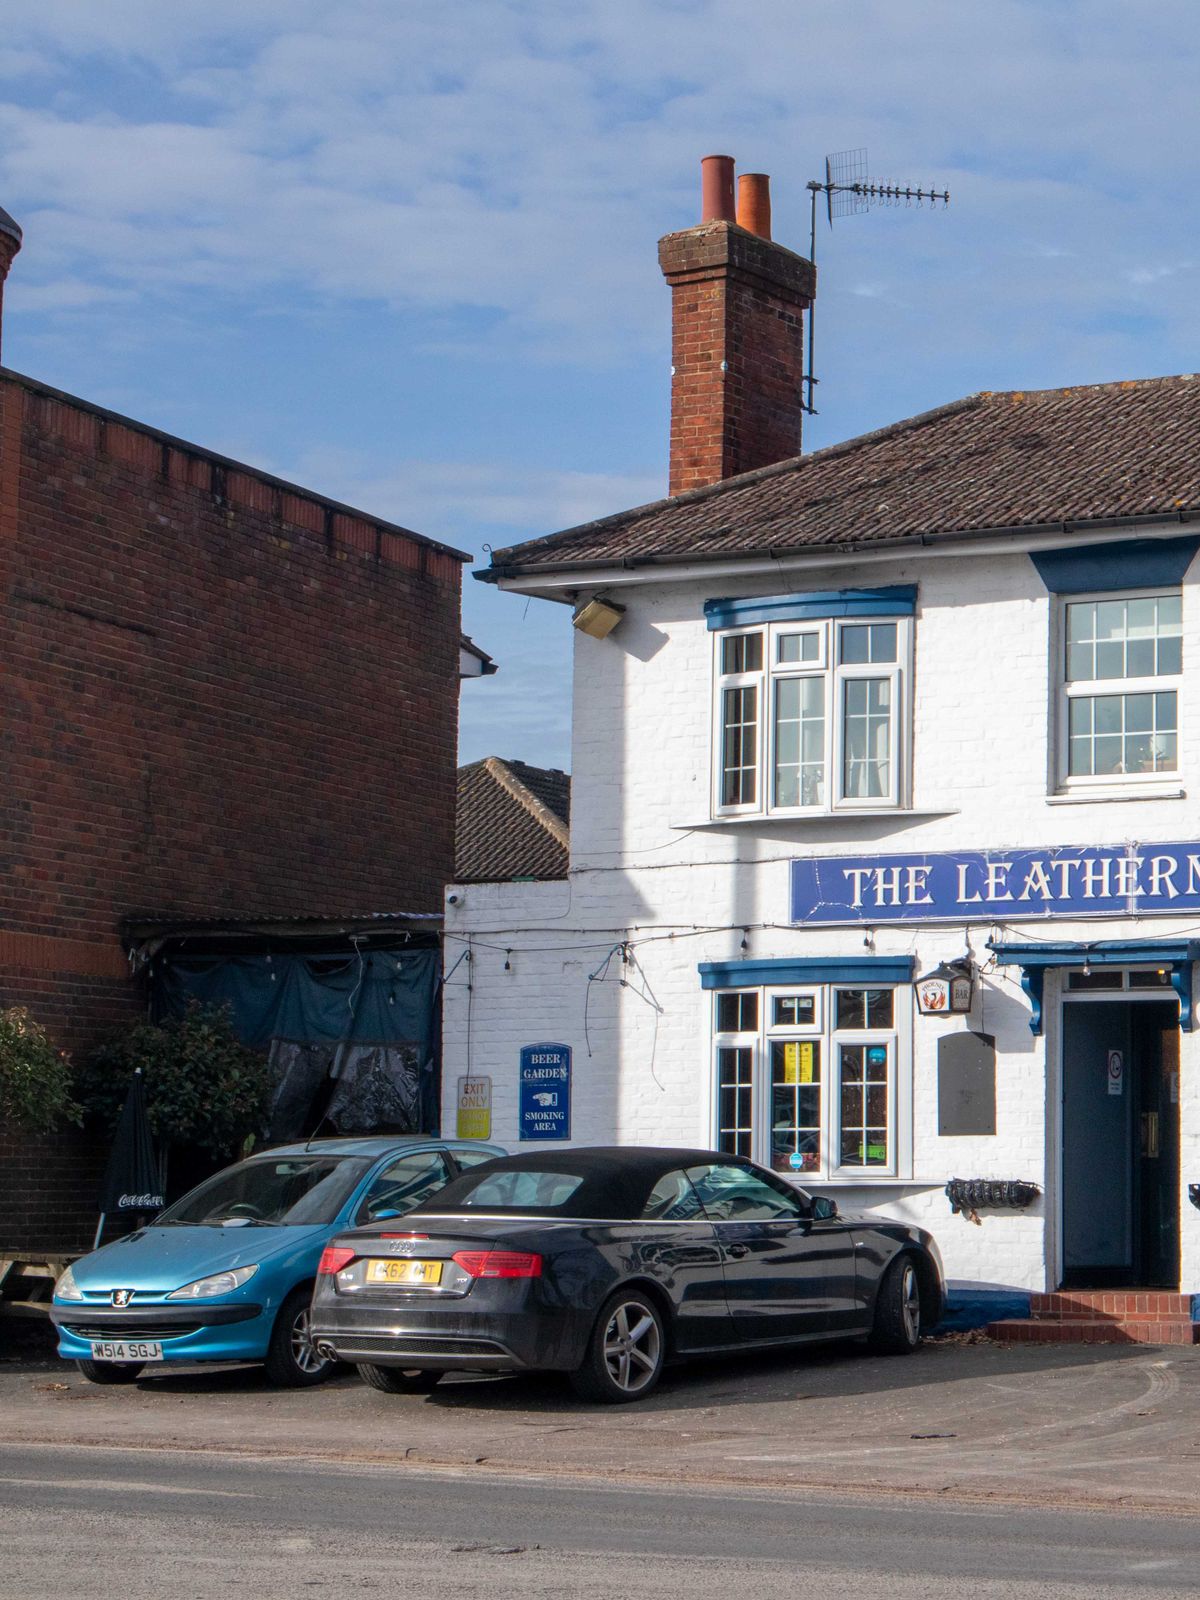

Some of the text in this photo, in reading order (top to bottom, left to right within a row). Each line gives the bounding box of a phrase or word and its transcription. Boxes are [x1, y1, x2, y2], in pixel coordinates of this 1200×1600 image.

[843, 865, 935, 907] THE
[955, 989, 969, 999] BAR
[531, 1053, 561, 1065] BEER
[523, 1068, 568, 1079] GARDEN
[463, 1083, 486, 1095] EXIT
[461, 1096, 488, 1108] ONLY
[525, 1111, 565, 1121] SMOKING
[533, 1122, 557, 1131] AREA
[95, 1343, 159, 1358] W514 SGJ
